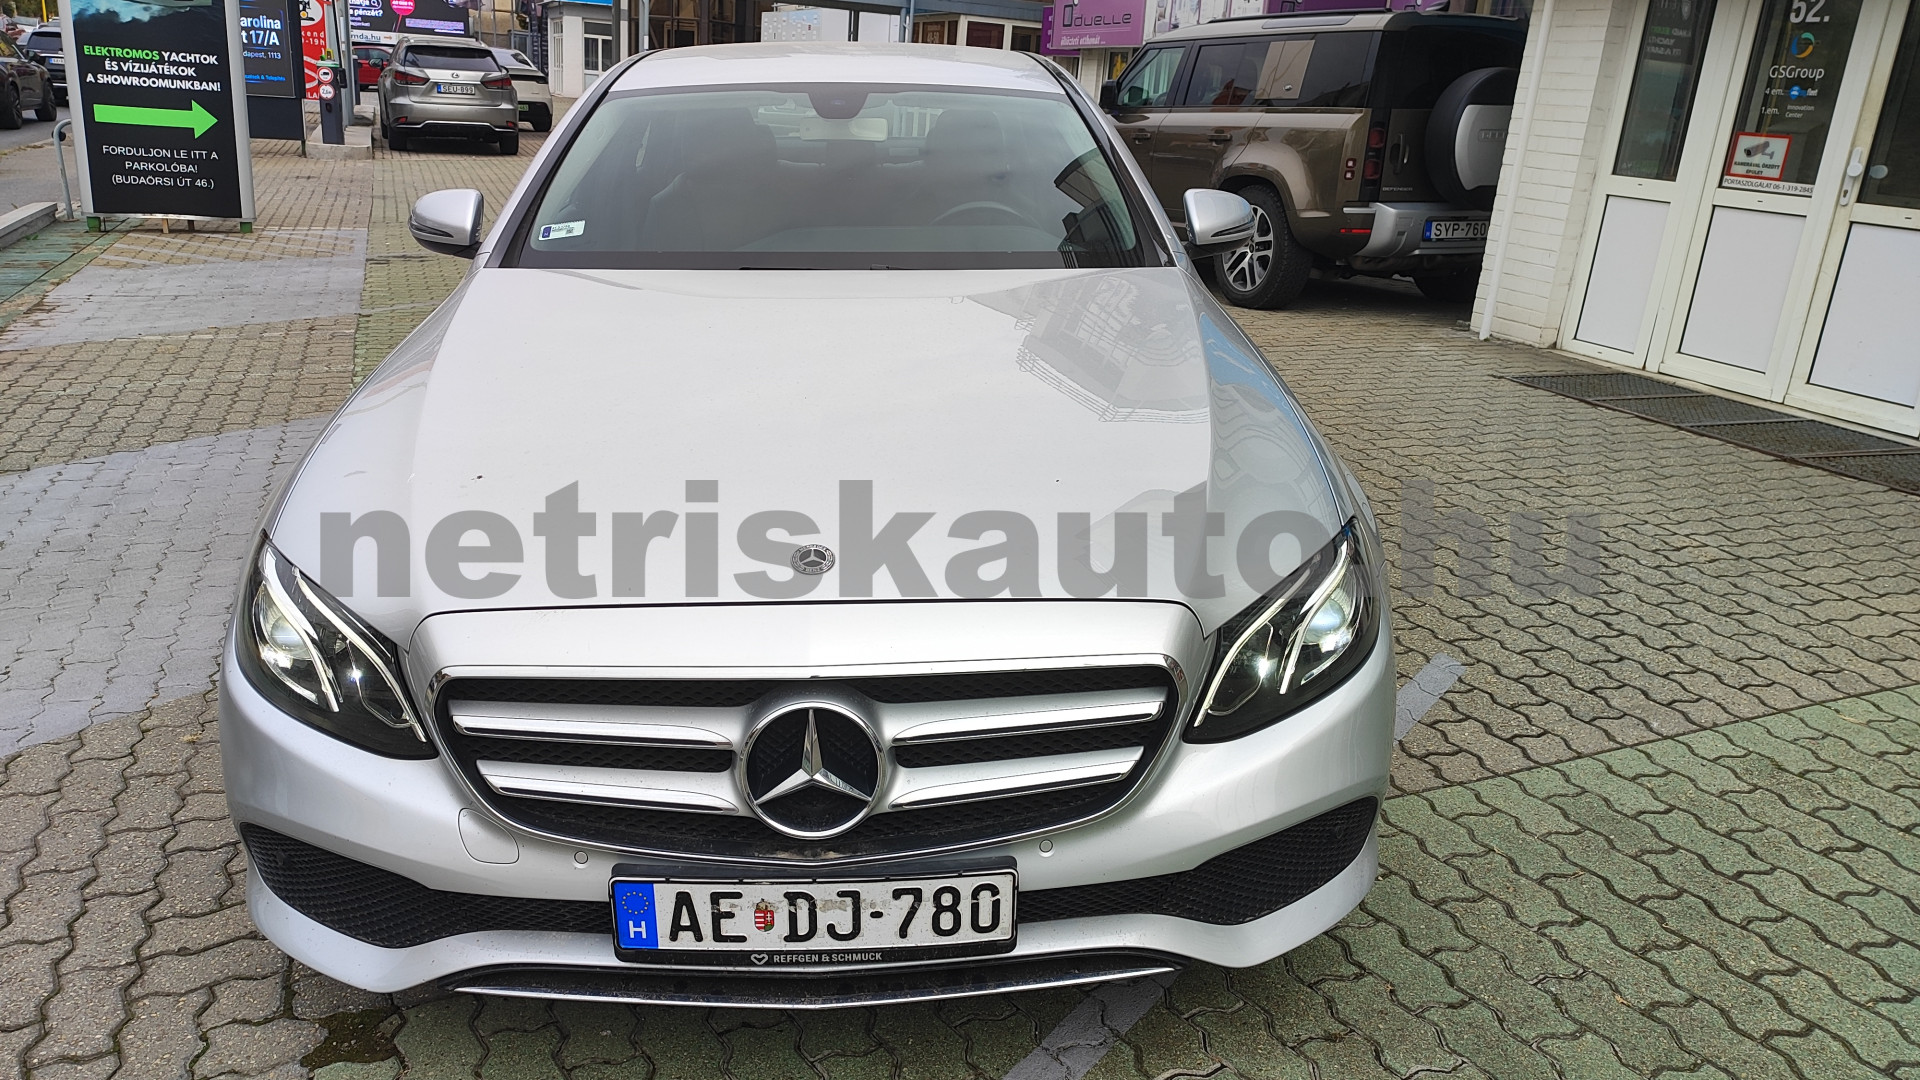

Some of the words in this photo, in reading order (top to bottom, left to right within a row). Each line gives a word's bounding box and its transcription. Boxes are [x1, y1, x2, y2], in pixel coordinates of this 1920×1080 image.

[1789, 0, 1830, 24] 52.
[240, 15, 281, 29] arolina
[241, 30, 248, 43] t
[250, 30, 280, 46] 17/A
[350, 33, 381, 41] mda.hu
[83, 45, 160, 60] ELEKTROMOS
[161, 51, 219, 65] YACHTOK
[243, 50, 267, 59] dapest,
[104, 58, 119, 71] ÉS
[120, 60, 197, 77] VÍZIJÁTÉKOK
[1769, 65, 1825, 82] GSGroup
[86, 73, 95, 83] A
[97, 74, 221, 92] SHOWROOMUNKBAN!
[102, 145, 171, 158] FORDULJON
[174, 149, 188, 159] LE
[191, 150, 208, 159] ITT
[210, 151, 219, 160] A
[125, 160, 198, 173] PARKOLÓBA!
[177, 176, 192, 187] ÚT
[194, 178, 215, 189] 46.)
[1434, 222, 1486, 237] SYP-760
[669, 891, 748, 943] AE
[783, 882, 1001, 943] DJ-780
[628, 920, 647, 939] H
[773, 954, 819, 963] REFFGEN
[821, 953, 830, 962] &
[831, 952, 882, 962] SCHMUCK
